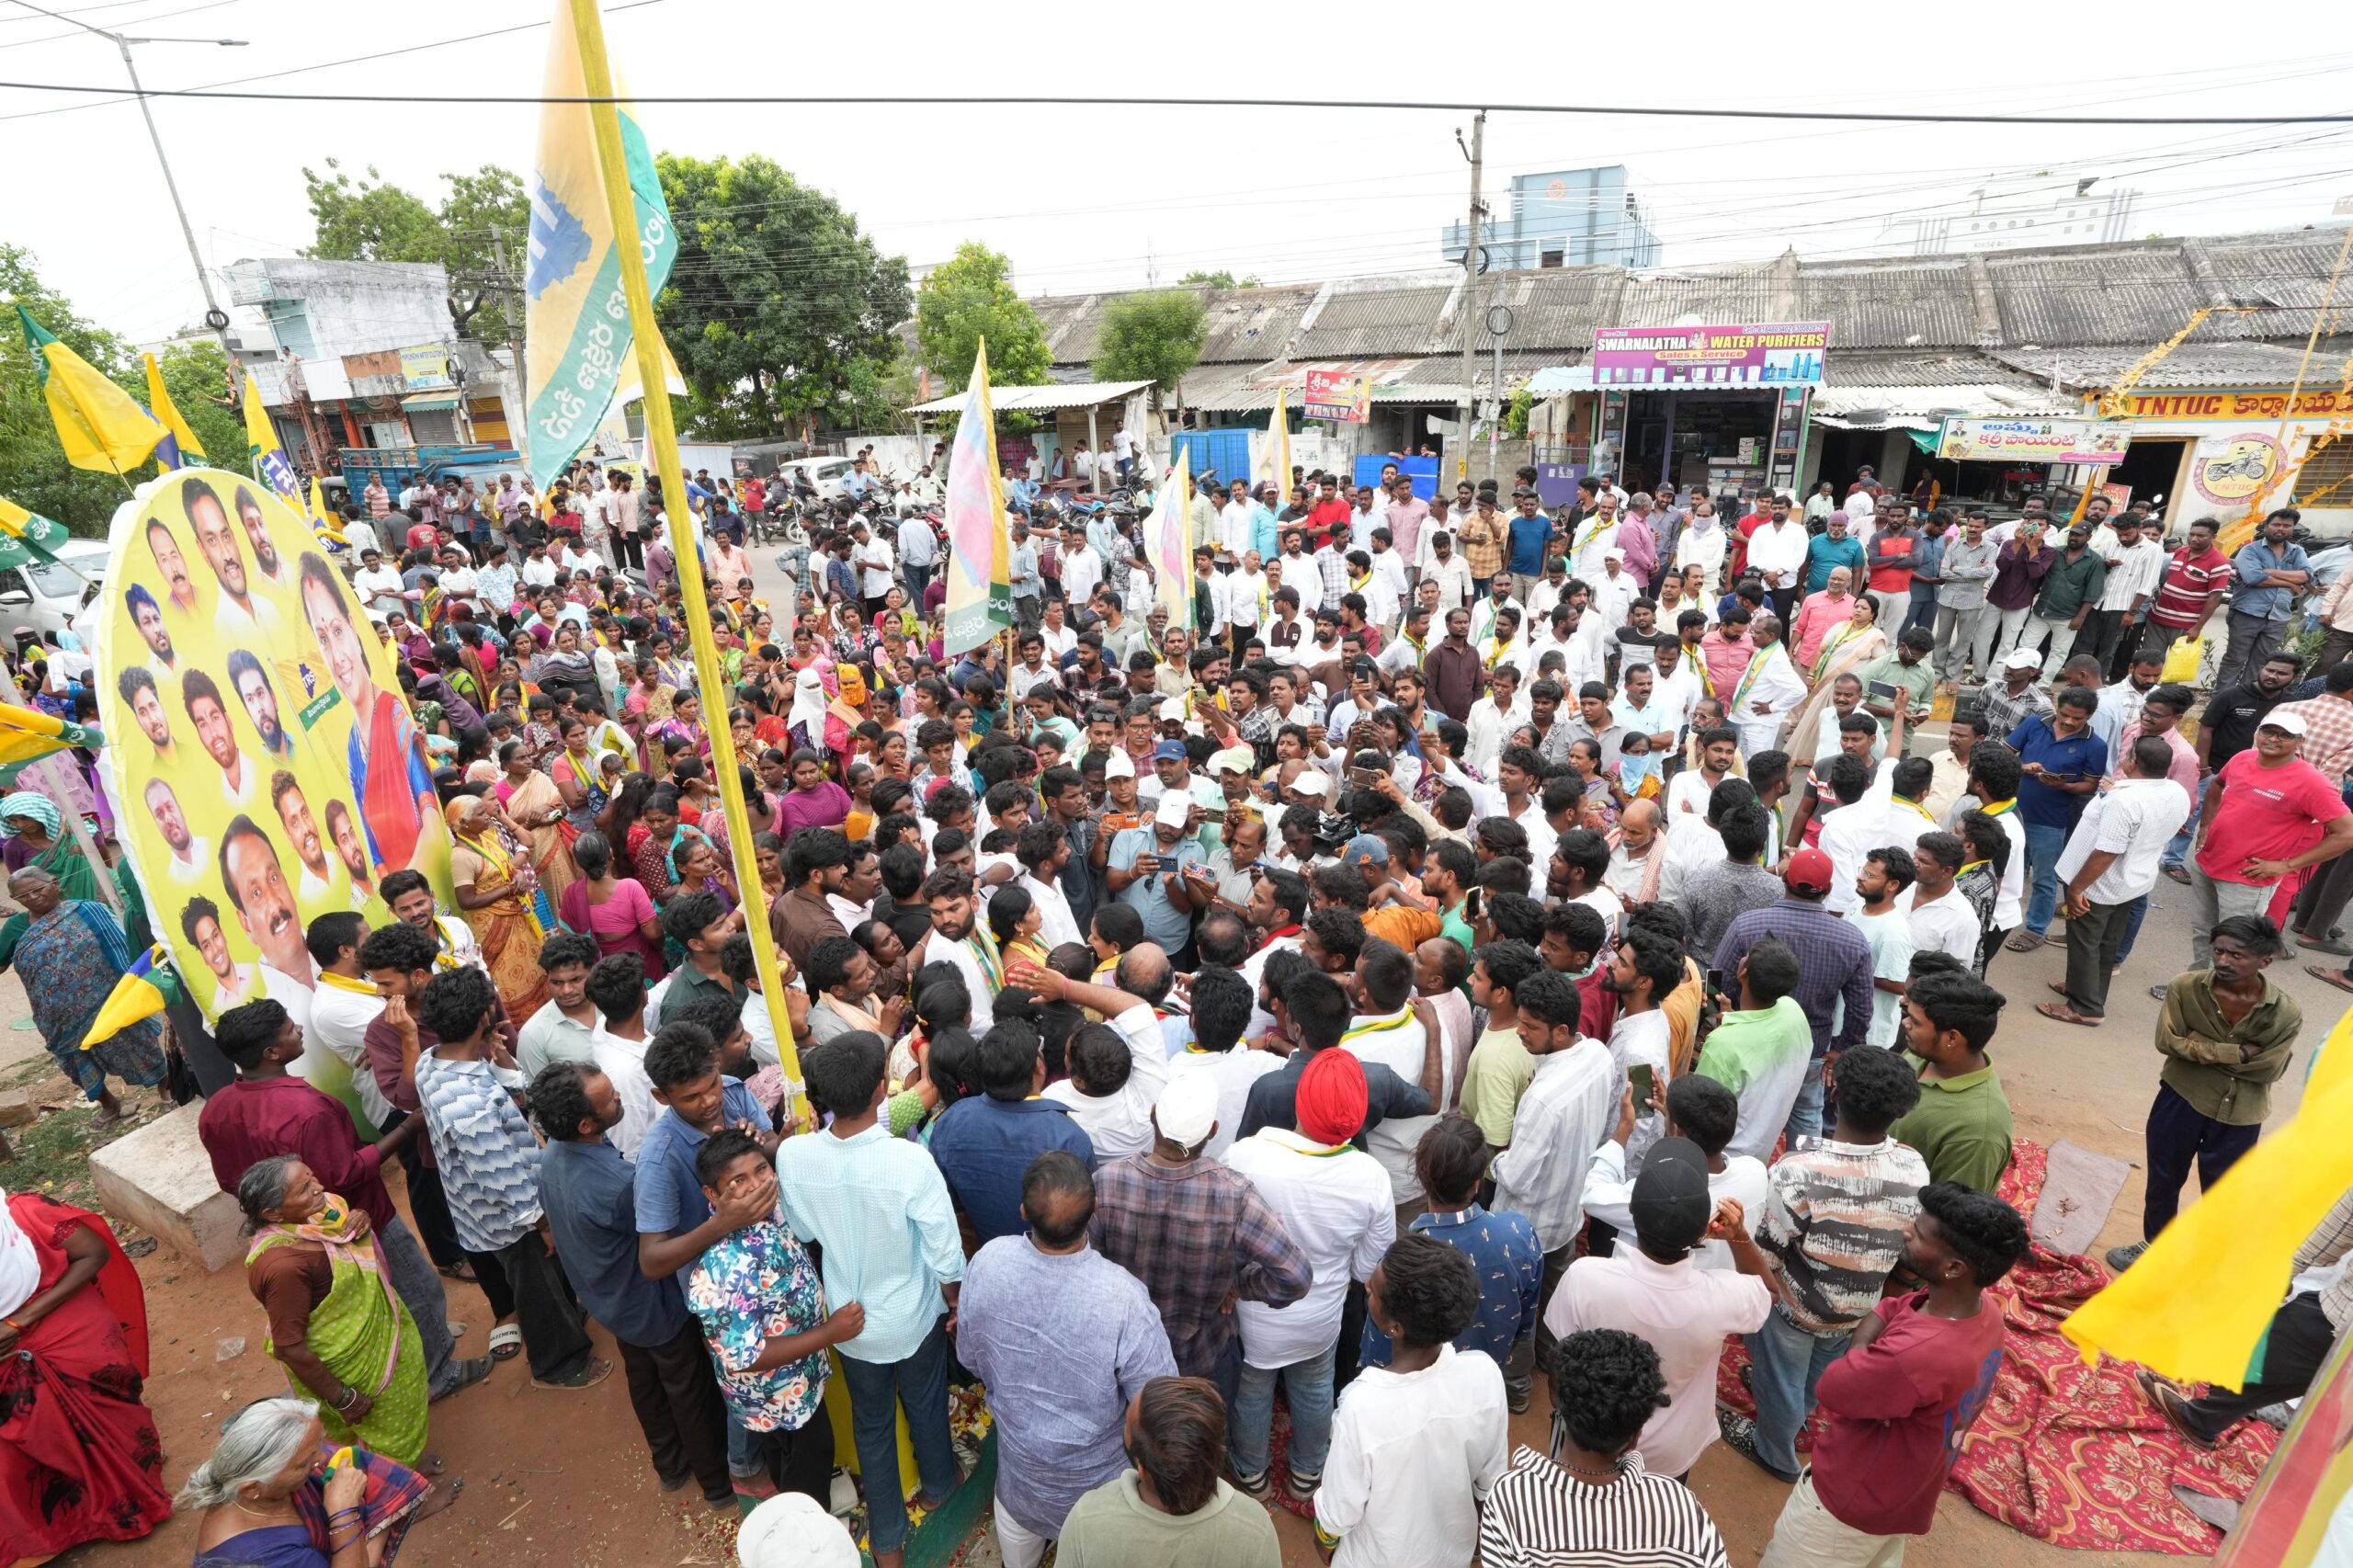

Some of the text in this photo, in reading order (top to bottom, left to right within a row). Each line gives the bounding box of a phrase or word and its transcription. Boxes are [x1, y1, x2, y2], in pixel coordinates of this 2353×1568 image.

[1597, 334, 1824, 351] SWARNALATHA WATER PURIFIERS
[1658, 350, 1689, 359] Sales
[1699, 349, 1744, 358] Service
[301, 672, 316, 689] TRS
